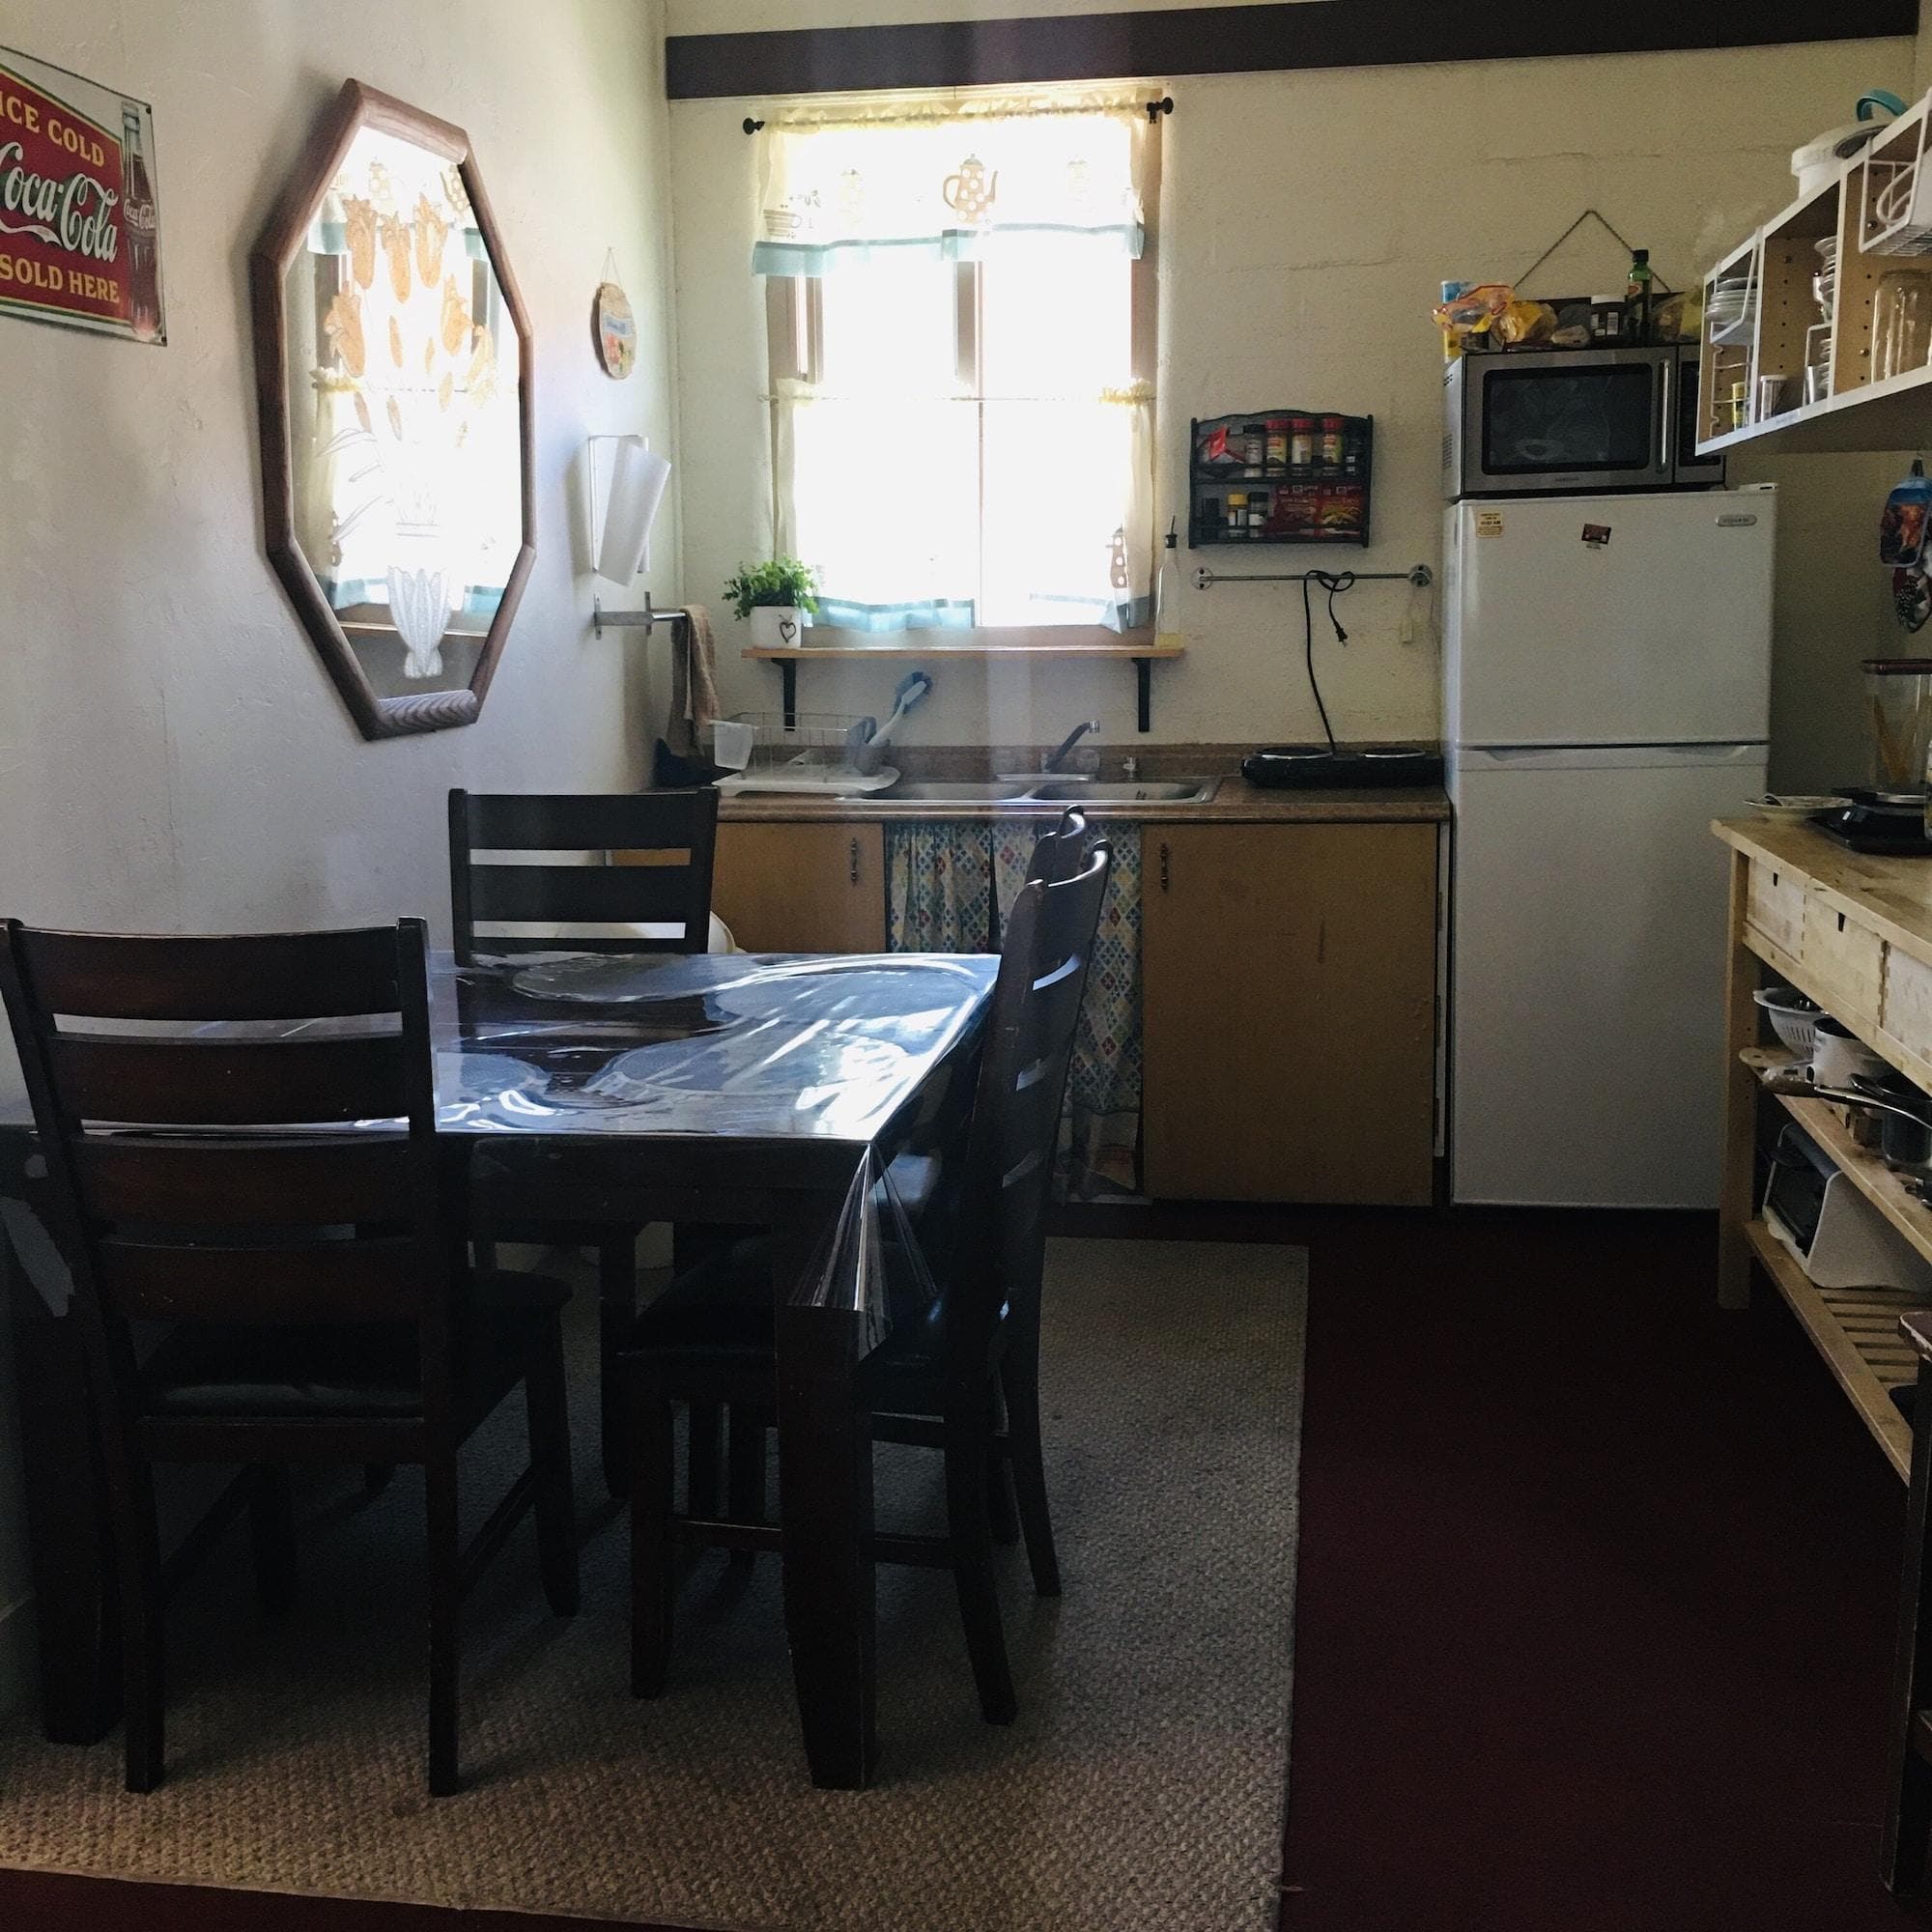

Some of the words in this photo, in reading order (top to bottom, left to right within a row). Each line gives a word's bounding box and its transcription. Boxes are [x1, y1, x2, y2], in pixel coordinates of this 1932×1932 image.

[48, 118, 105, 168] COLD
[0, 253, 64, 291] SOLD
[69, 269, 120, 304] HERE
